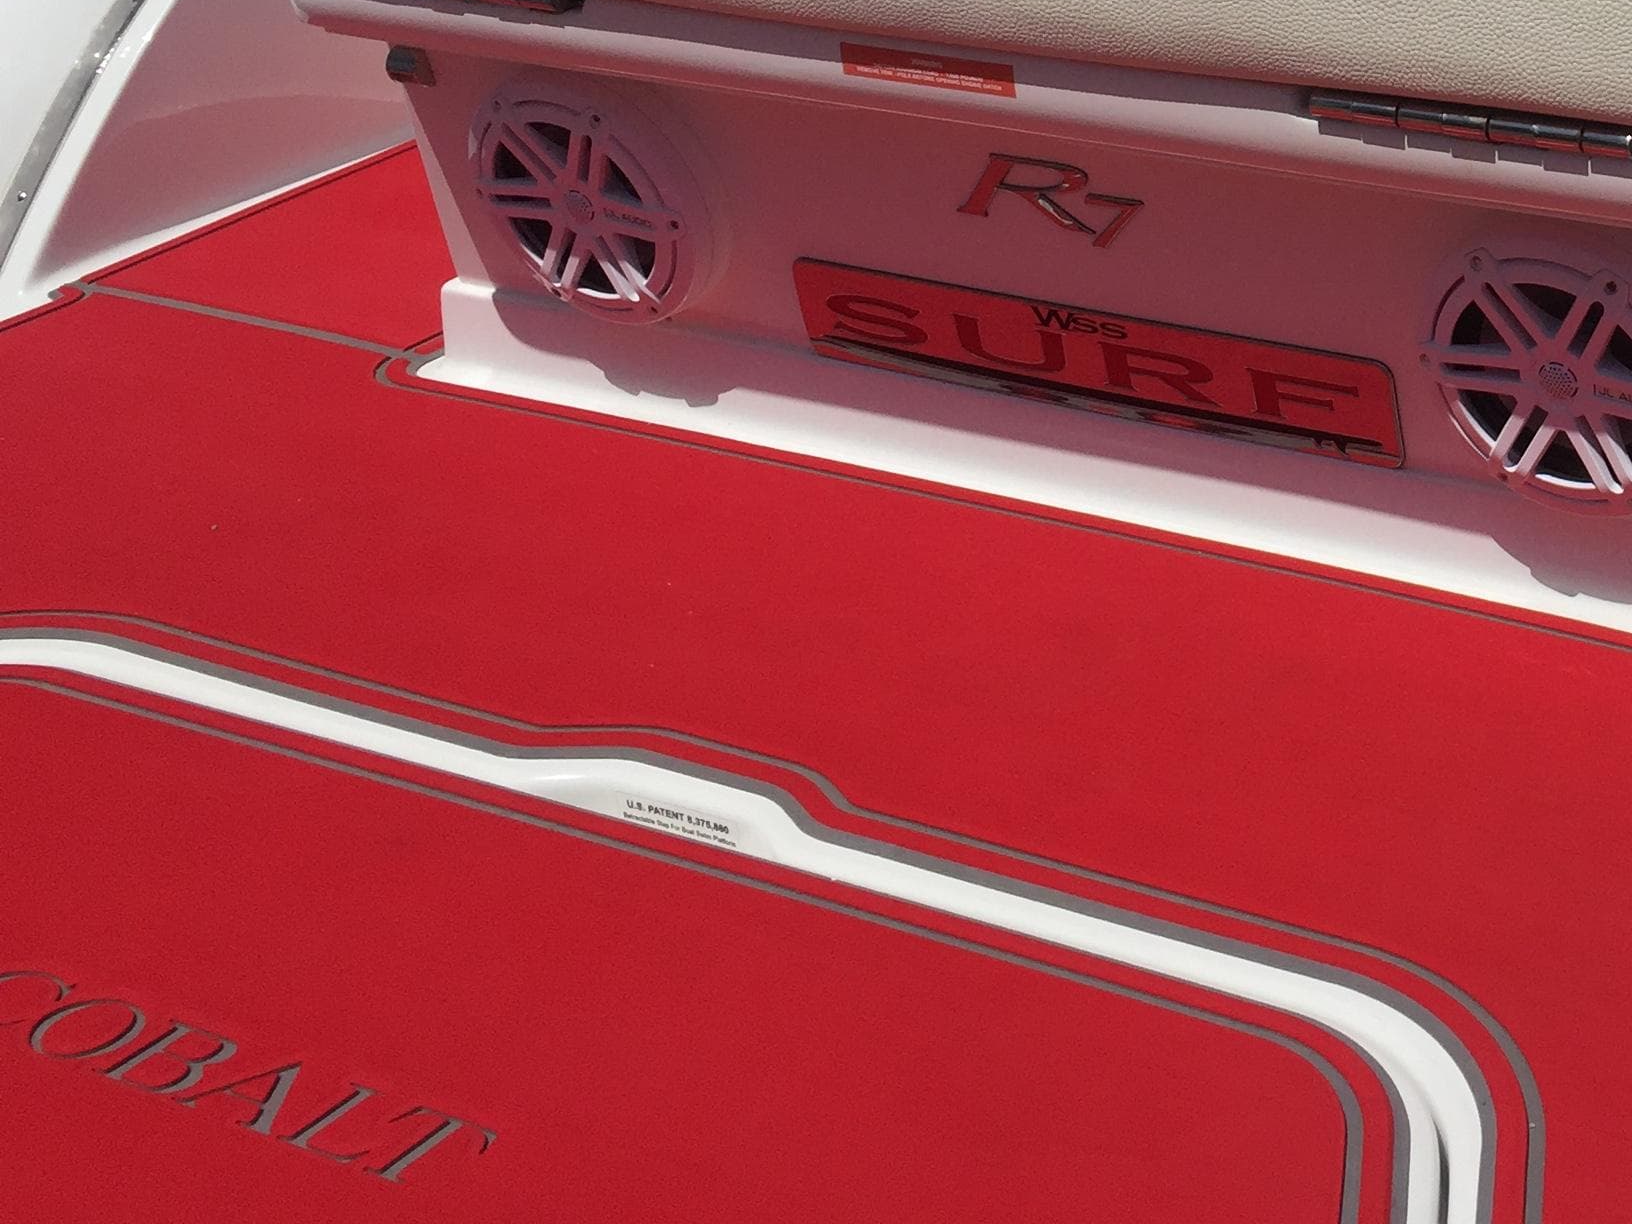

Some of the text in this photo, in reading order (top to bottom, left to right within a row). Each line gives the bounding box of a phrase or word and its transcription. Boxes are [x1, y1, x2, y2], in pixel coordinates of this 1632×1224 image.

[956, 152, 1145, 249] R7
[825, 293, 1360, 421] SURF
[626, 799, 646, 812] U.S.
[648, 805, 684, 822] PATENT
